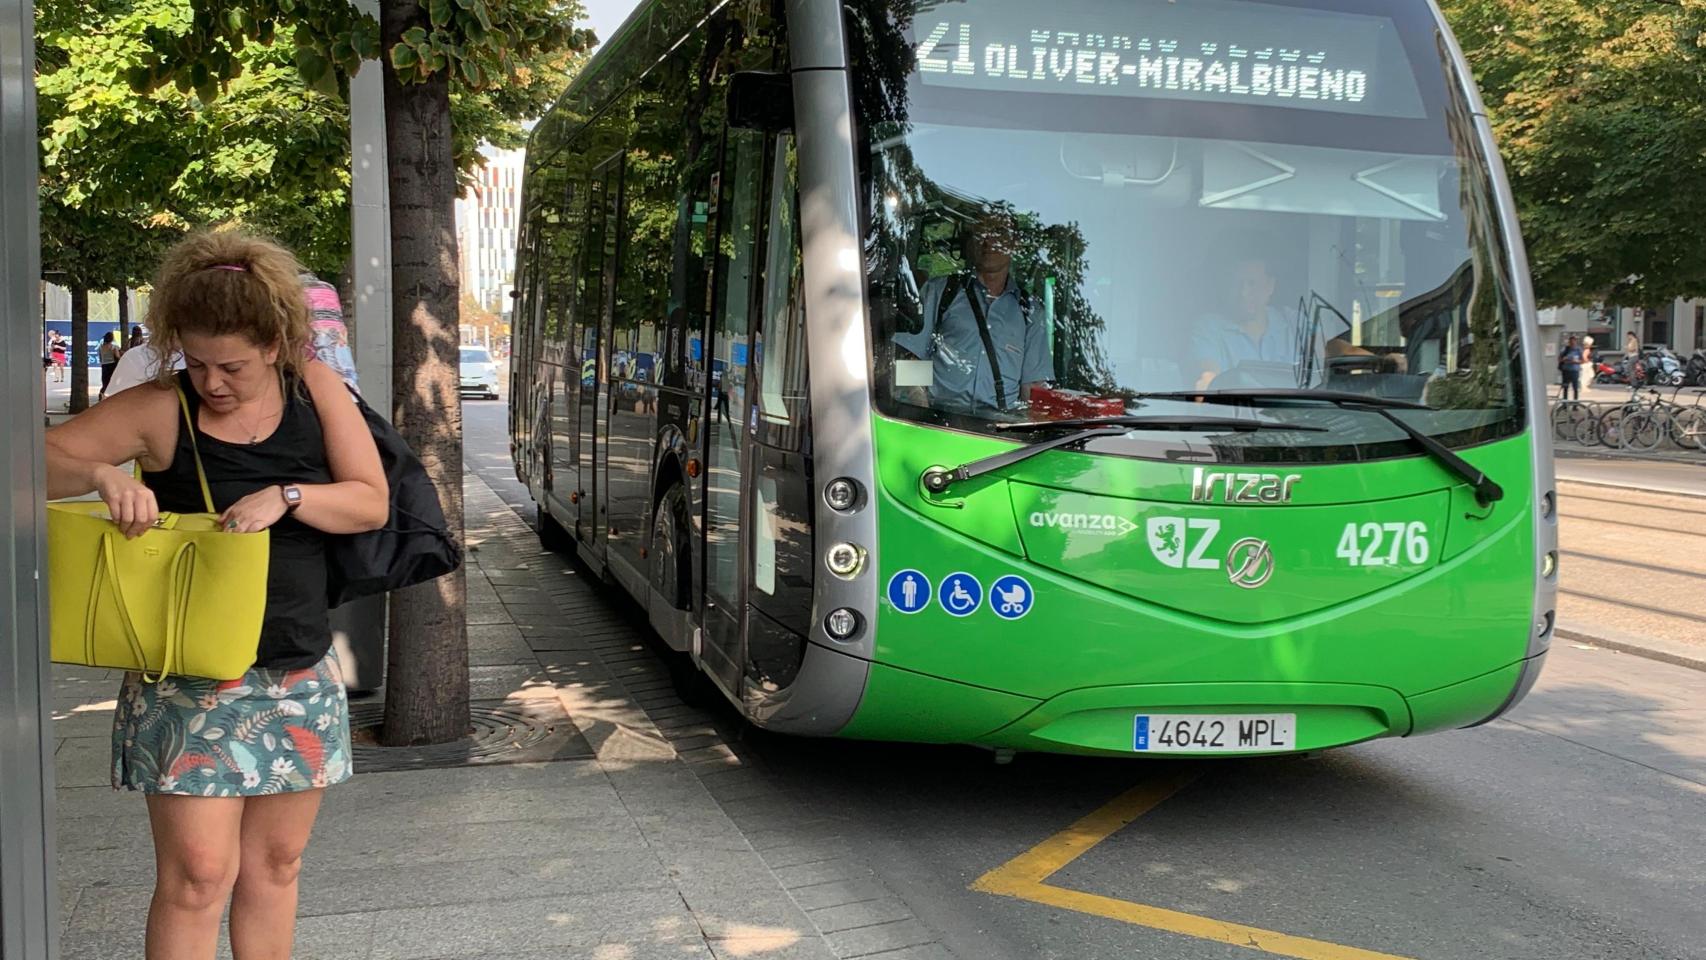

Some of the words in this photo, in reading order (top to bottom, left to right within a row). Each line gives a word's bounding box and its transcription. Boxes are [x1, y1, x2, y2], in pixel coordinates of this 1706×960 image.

[984, 43, 1366, 102] OLIVER-MIRALBUENO
[1192, 467, 1302, 503] Irizar
[1029, 511, 1117, 530] avanza
[1186, 518, 1221, 569] Z
[1336, 521, 1429, 566] 4276
[1138, 736, 1146, 744] E
[1158, 720, 1225, 747] 4642
[1238, 719, 1284, 746] MPL
